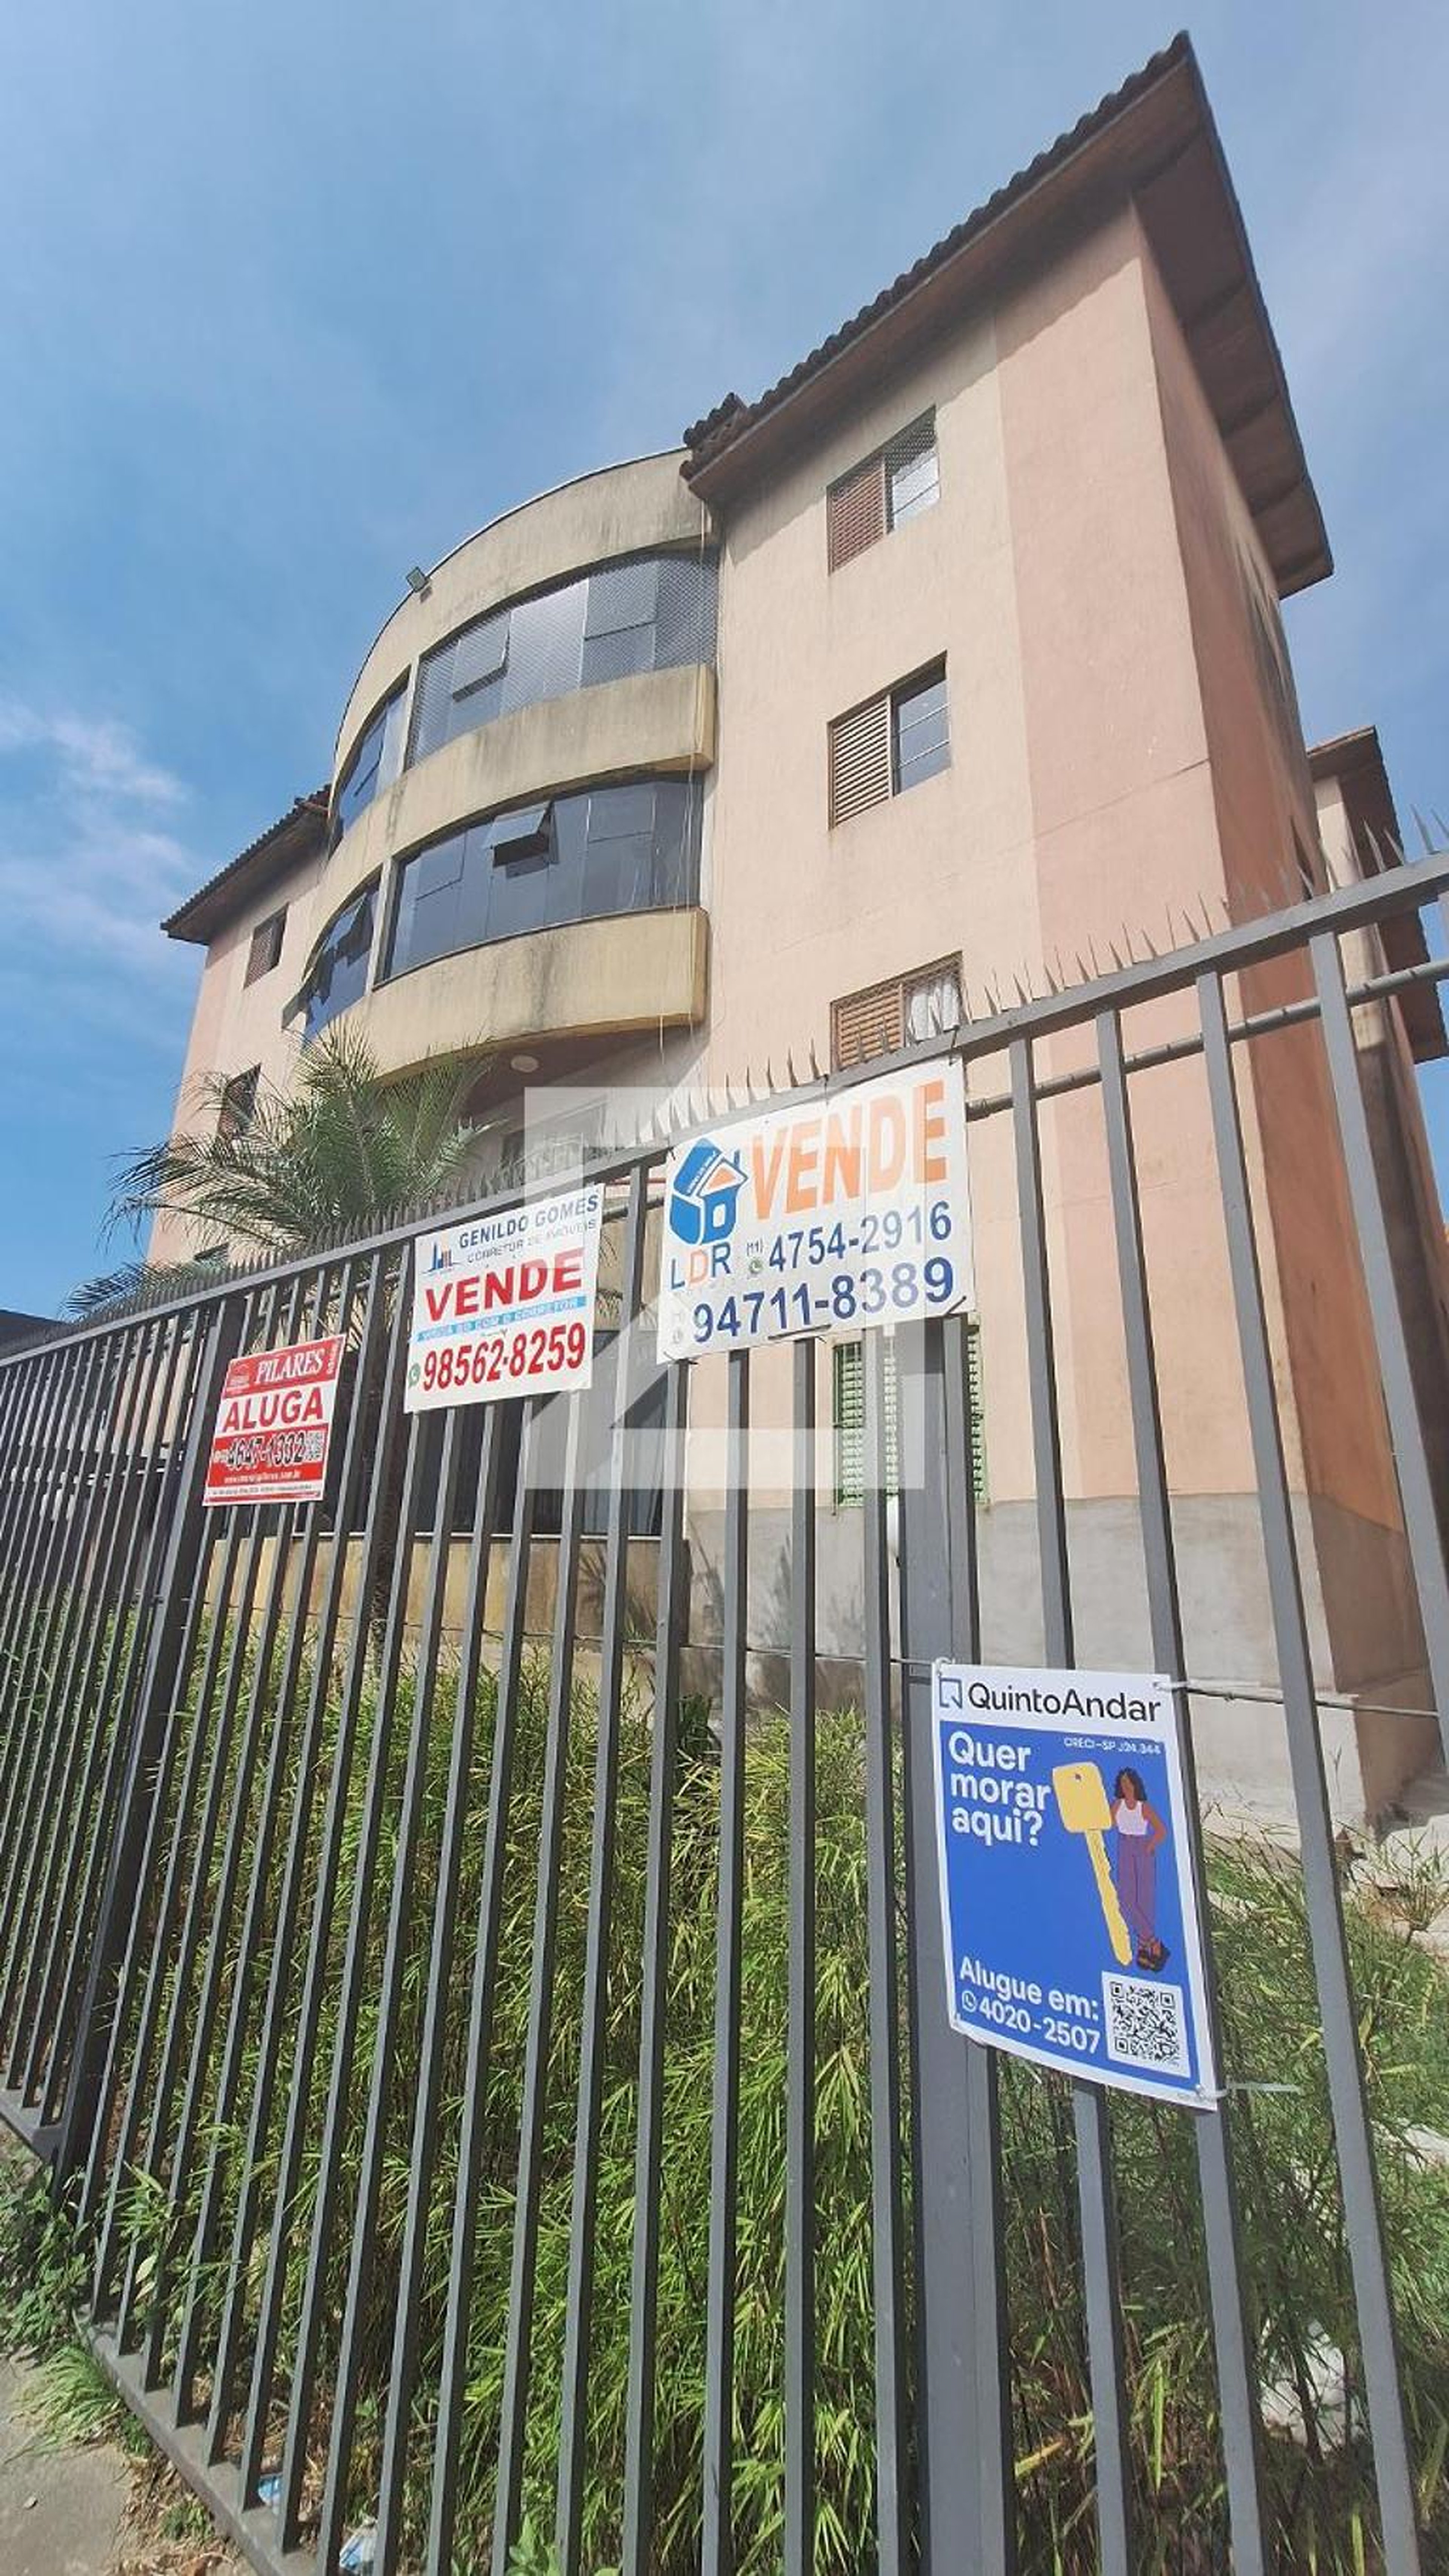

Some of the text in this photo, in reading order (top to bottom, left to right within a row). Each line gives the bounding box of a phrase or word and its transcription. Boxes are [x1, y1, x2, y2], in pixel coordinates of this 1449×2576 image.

[751, 1080, 947, 1220] VENDE
[460, 1195, 598, 1249] GENILDO GOMES
[769, 1201, 951, 1271] 4754-2916
[426, 1248, 585, 1321] VENDE
[671, 1242, 731, 1290] LDR
[693, 1256, 954, 1343] 94711-8389
[256, 1350, 323, 1384] PILARES
[423, 1323, 585, 1392] 98562-8259
[223, 1387, 323, 1432] ALUGA
[968, 1682, 1160, 1722] QuintoAndar
[949, 1731, 1032, 1772] Quer
[1064, 1737, 1116, 1751] CRECI-SP
[951, 1772, 1051, 1811] morar
[952, 1807, 1043, 1846] aqui?
[960, 1957, 1100, 2021] Alugue em:
[979, 1998, 1101, 2055] 4020-2507
